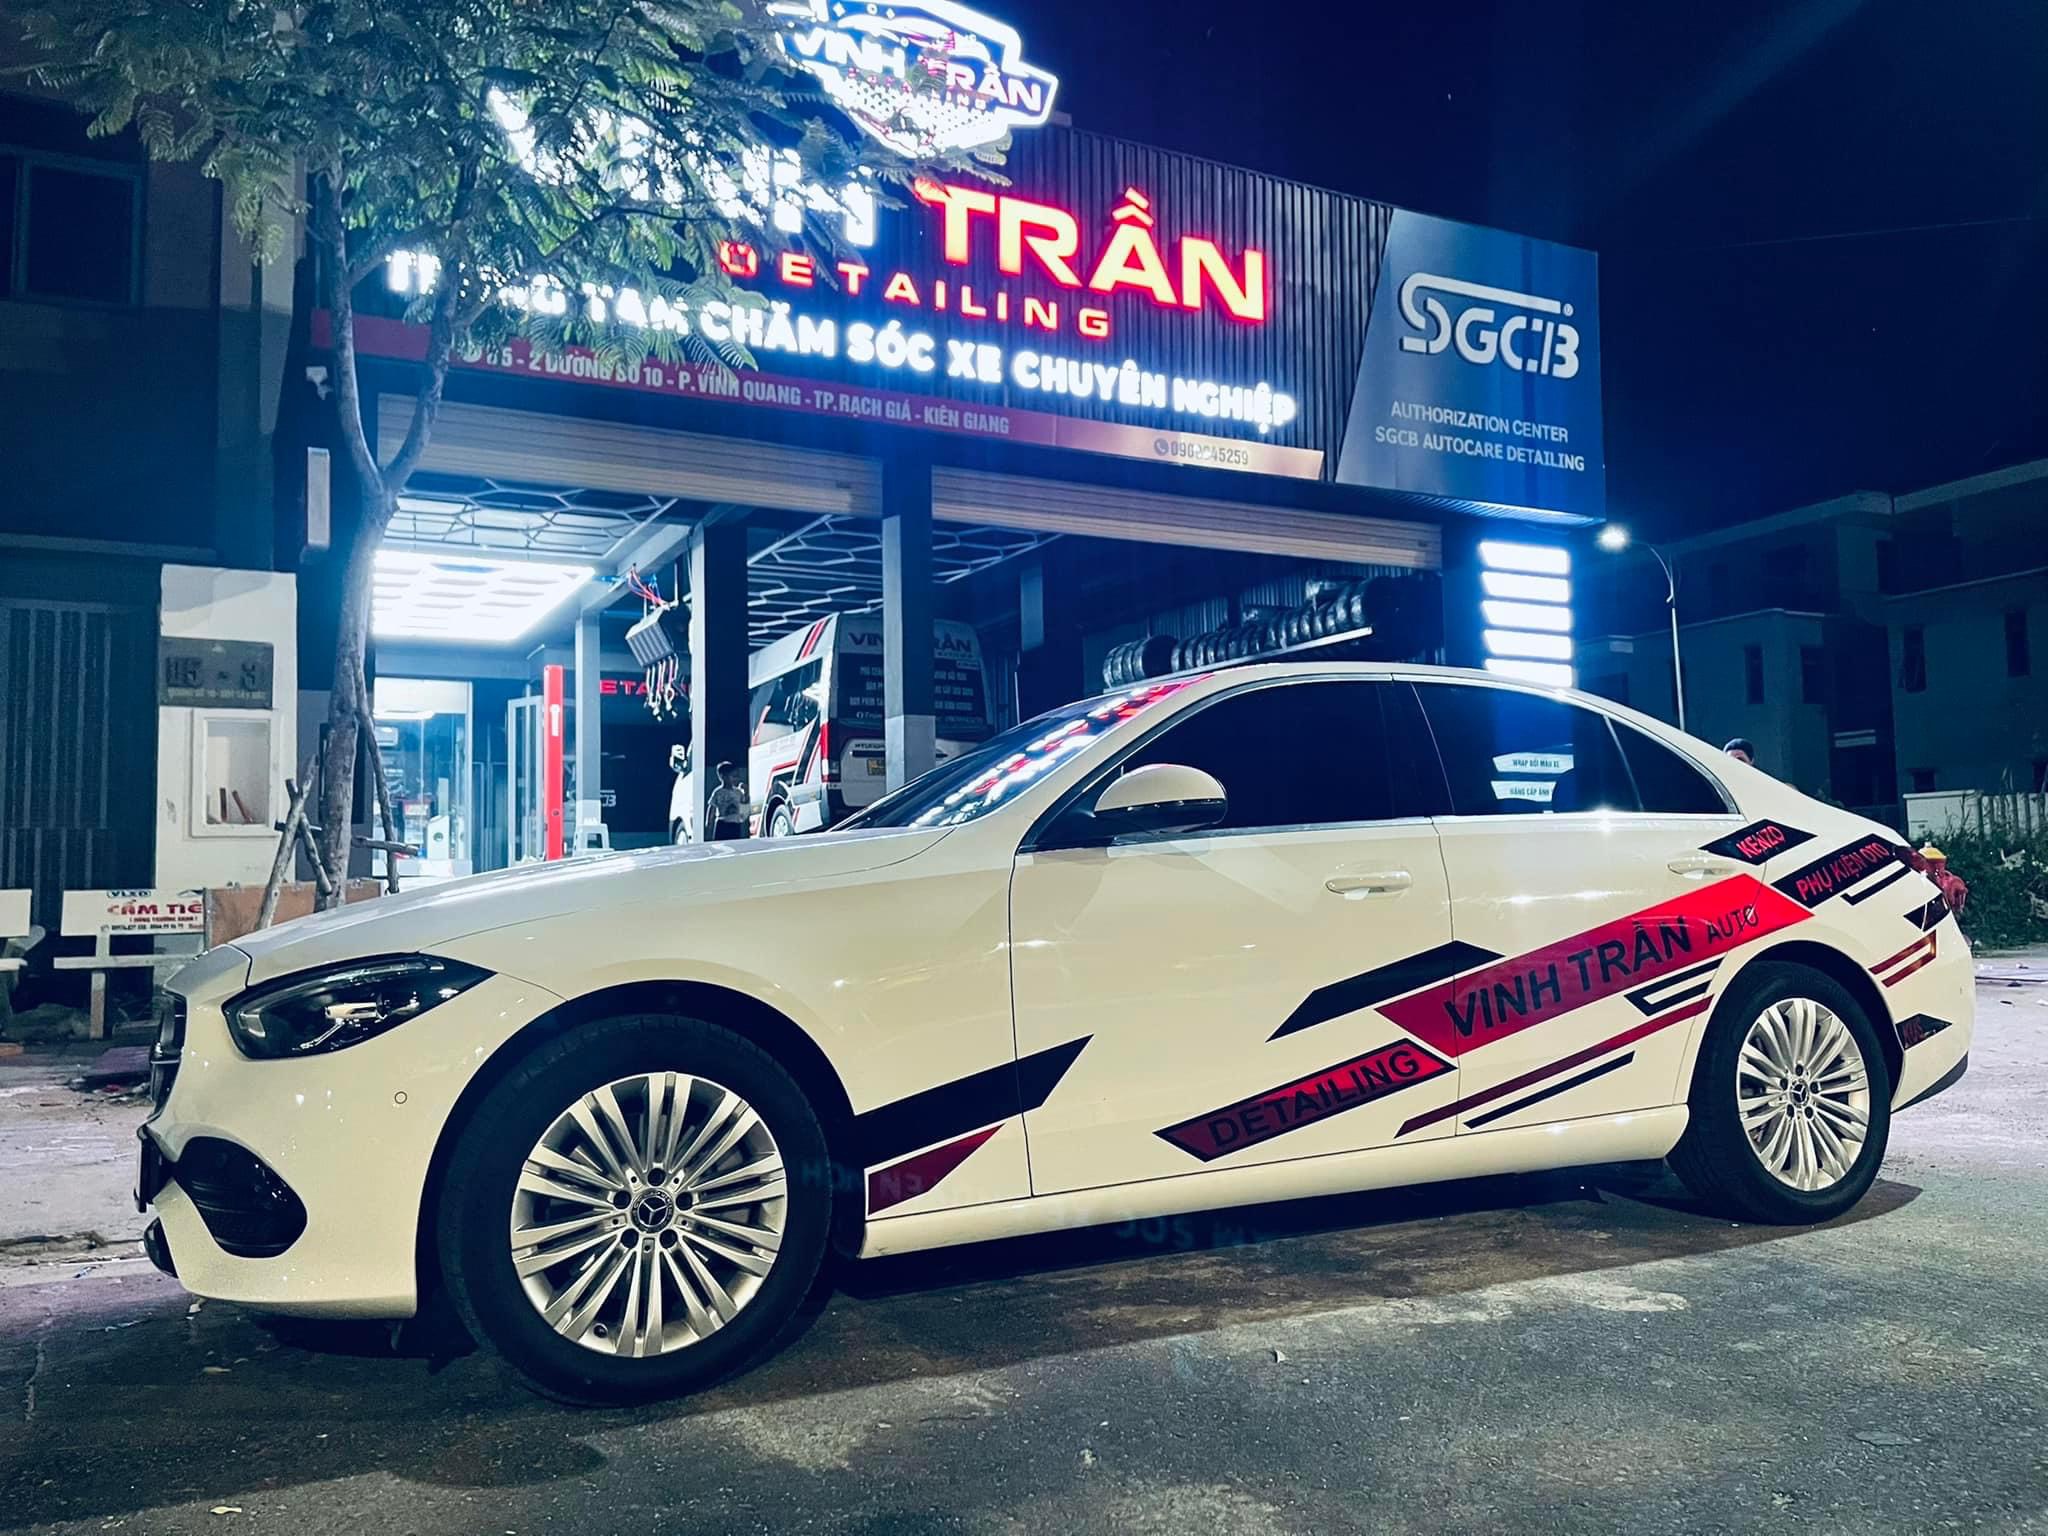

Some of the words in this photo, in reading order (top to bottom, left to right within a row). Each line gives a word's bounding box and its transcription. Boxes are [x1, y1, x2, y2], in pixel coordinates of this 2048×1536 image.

[794, 27, 906, 79] VINH
[719, 241, 1110, 338] DETAILING
[915, 186, 1265, 323] TRẦN
[1400, 272, 1580, 379] SGCB
[643, 366, 663, 388] 10
[743, 380, 801, 405] QUANG
[885, 400, 912, 422] GIÁ
[924, 405, 959, 428] KIÊN
[963, 412, 1009, 434] GIANG
[700, 300, 835, 356] CHĂM
[847, 319, 935, 372] SÓC
[947, 338, 1002, 384] XE
[1012, 350, 1167, 408] CHUYÊN
[1173, 377, 1296, 434] NGHIỆP
[1375, 426, 1418, 447] SGCB
[1423, 433, 1503, 460] AUTOCARE
[1506, 446, 1585, 472] DETAILING
[1391, 401, 1510, 434] AUTHORIZATION
[1512, 420, 1569, 443] CENTER
[1735, 825, 1785, 859] KENZO
[1796, 870, 1833, 902] PHỤ
[1833, 853, 1863, 884] KIỆN
[1443, 963, 1562, 1039] VINH
[1568, 915, 1694, 992] TRẦN
[1706, 904, 1760, 944] AUTO
[1207, 1050, 1420, 1147] DETAILING
